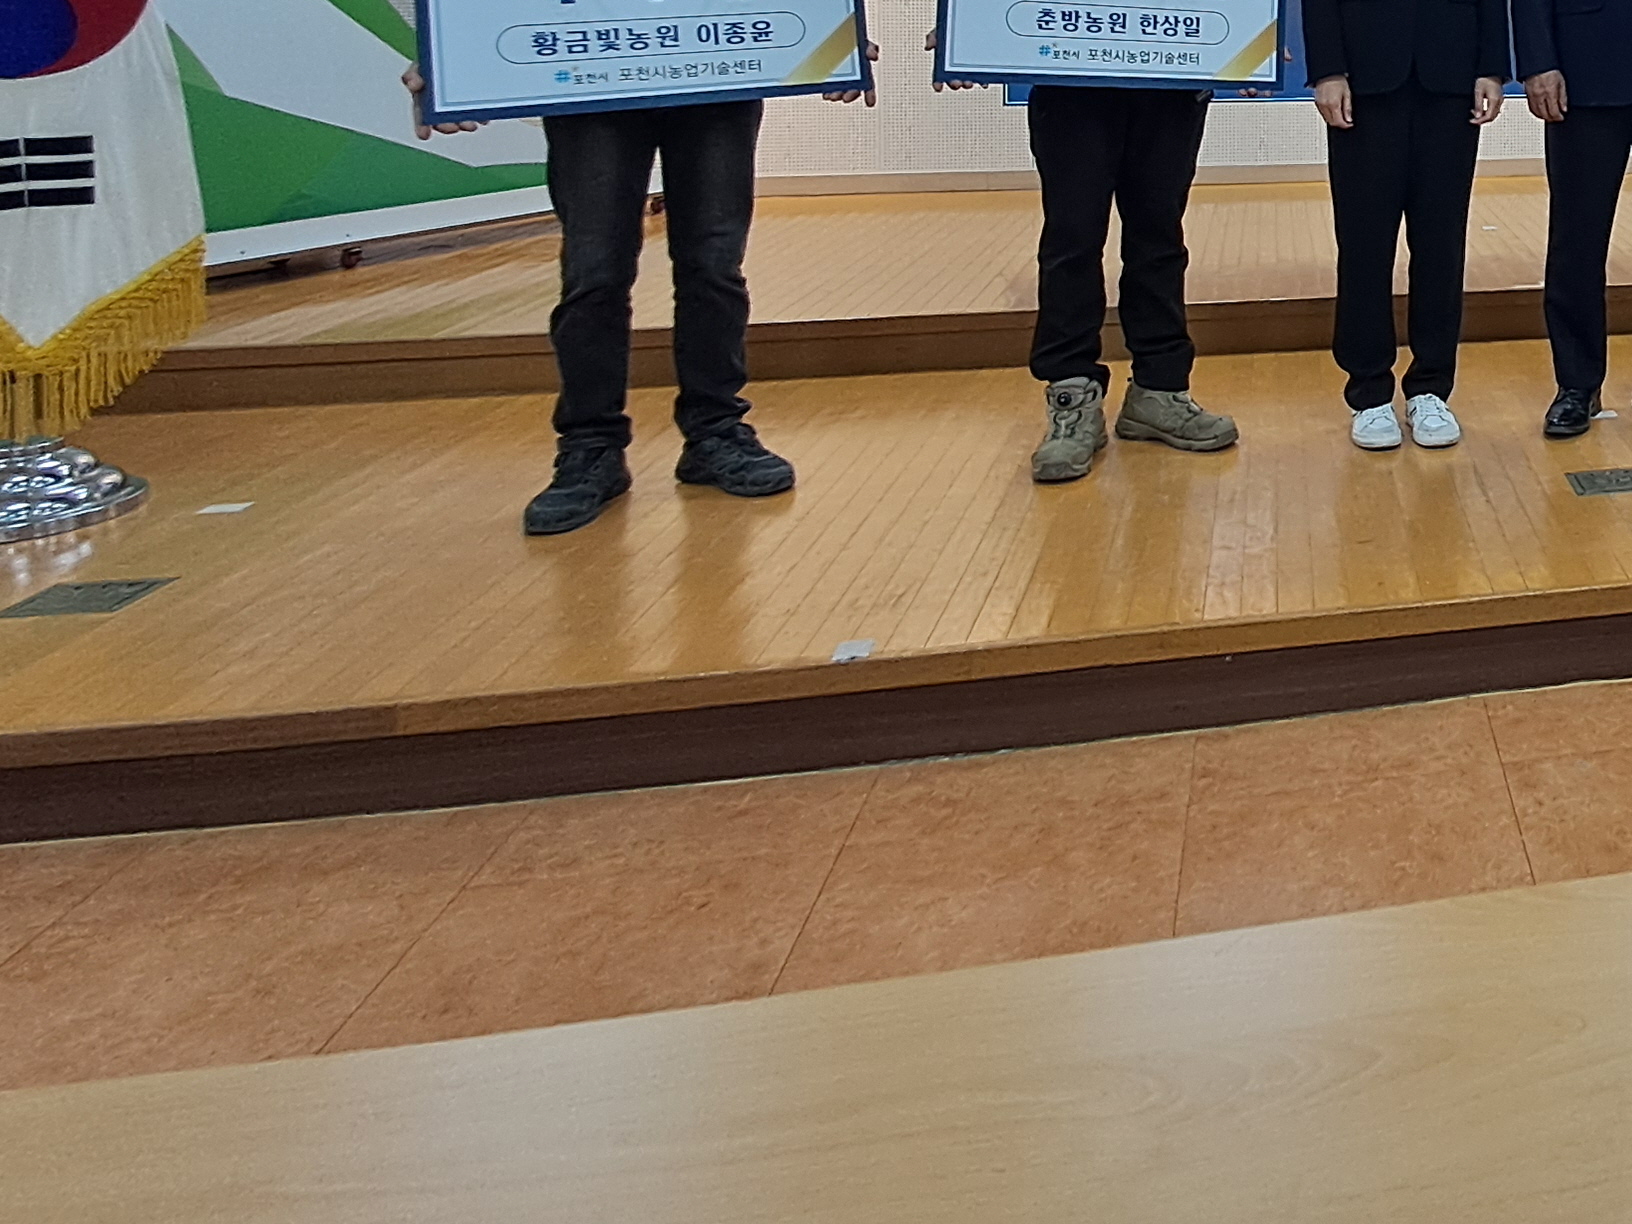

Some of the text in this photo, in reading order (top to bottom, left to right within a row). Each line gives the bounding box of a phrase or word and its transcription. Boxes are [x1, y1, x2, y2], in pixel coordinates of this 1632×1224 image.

[1036, 9, 1202, 38] 춘방농원 한상일
[530, 20, 775, 57] 황금빛농원 이종윤
[618, 58, 763, 81] 포천시농업기술센터
[1087, 48, 1201, 66] 포천시농업기술센터
